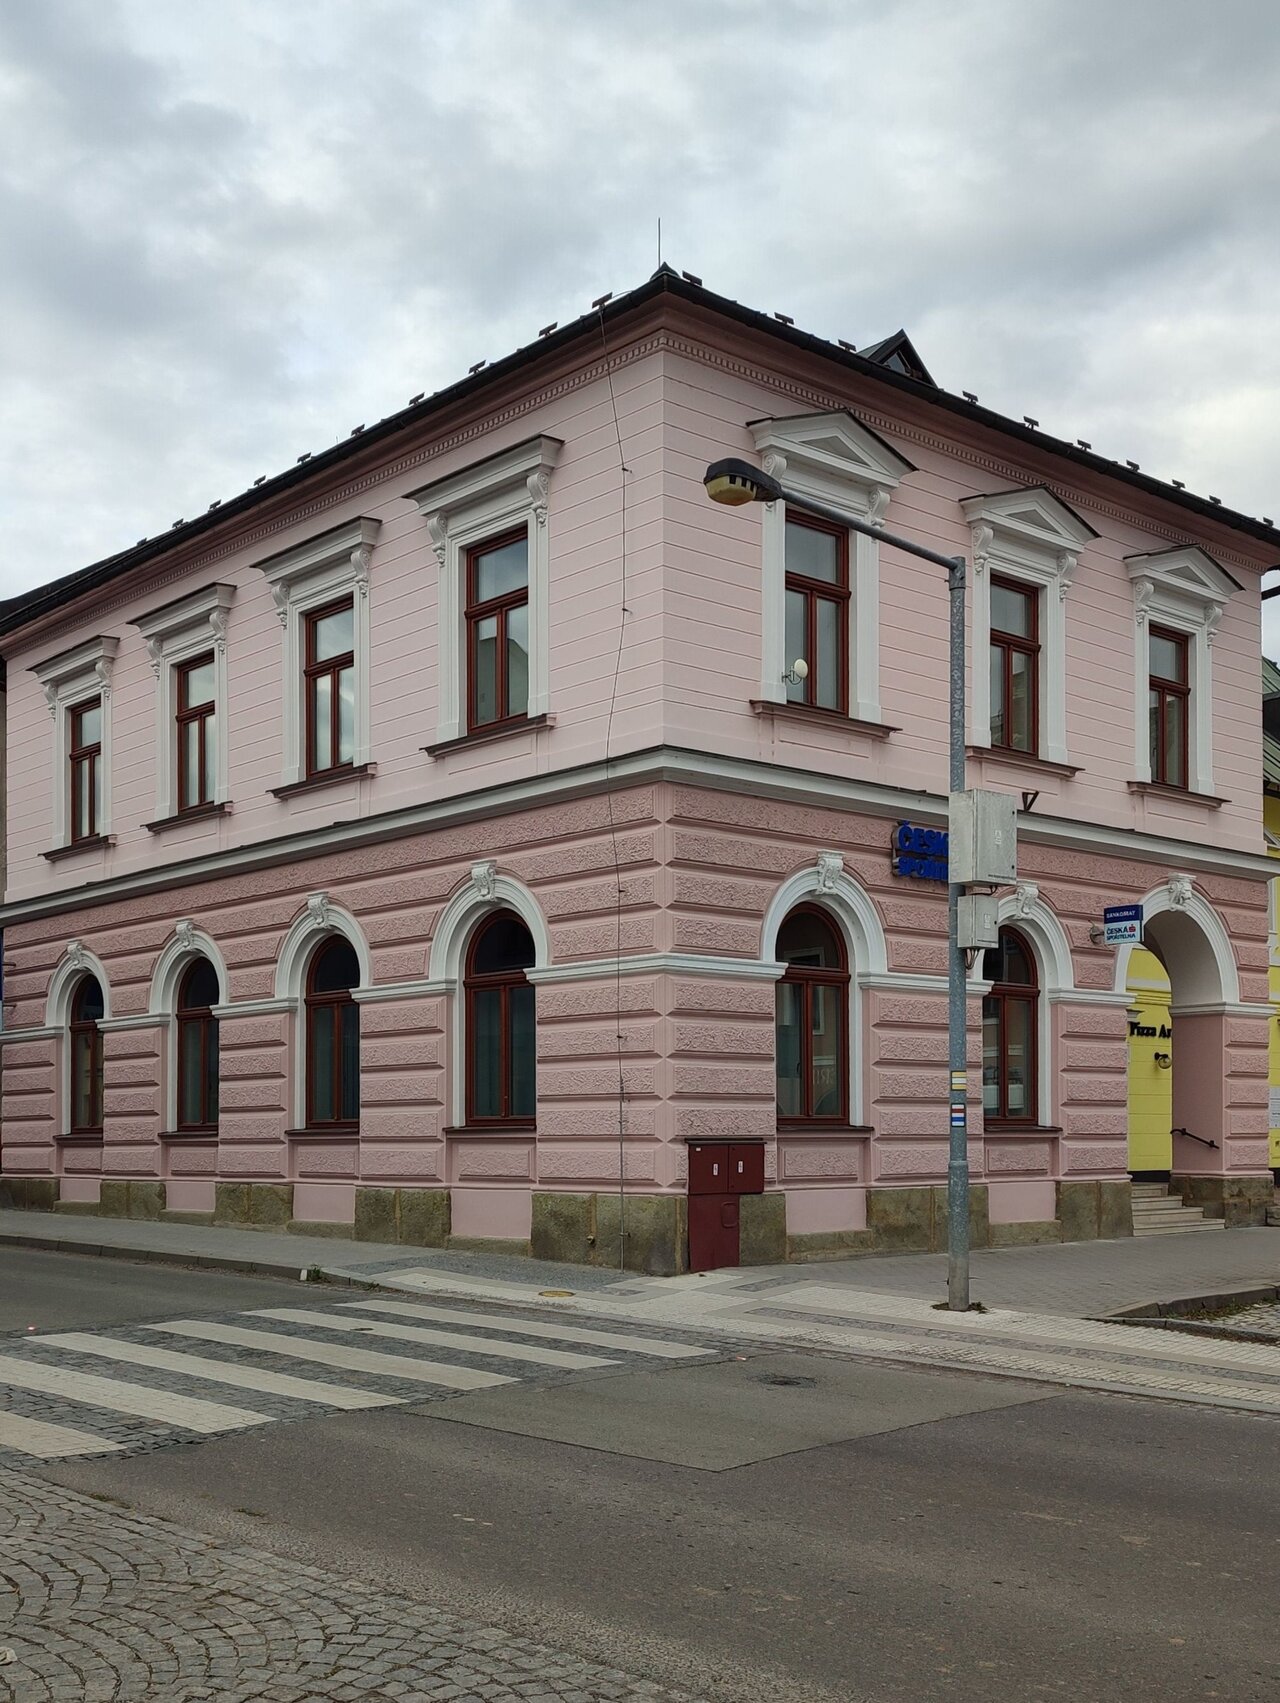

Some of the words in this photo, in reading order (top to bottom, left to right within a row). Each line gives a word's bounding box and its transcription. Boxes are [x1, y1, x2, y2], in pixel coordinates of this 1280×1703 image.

[1106, 910, 1136, 919] BANKOMAT
[1107, 925, 1128, 935] ČESKÁ
[1107, 933, 1136, 941] SPOŘITELNA
[1129, 1021, 1156, 1037] Pizza
